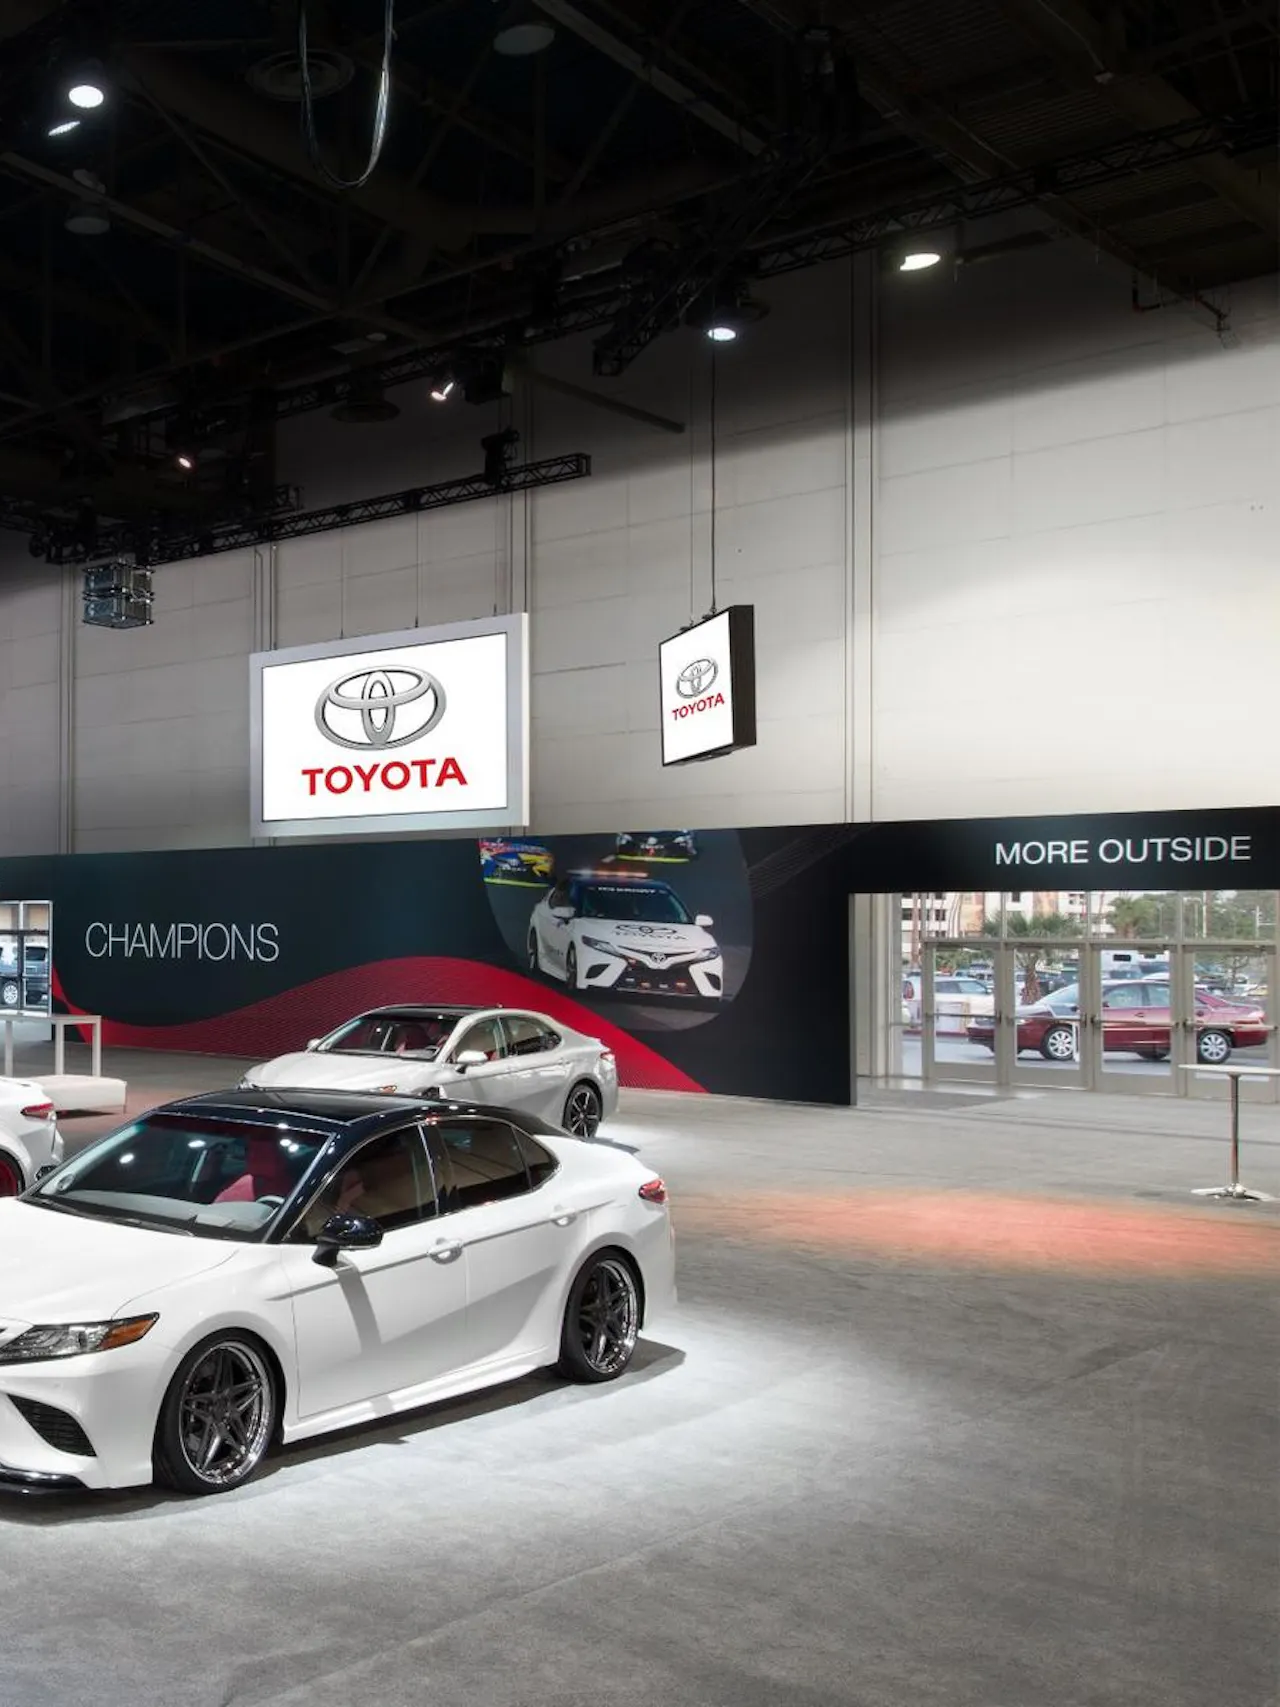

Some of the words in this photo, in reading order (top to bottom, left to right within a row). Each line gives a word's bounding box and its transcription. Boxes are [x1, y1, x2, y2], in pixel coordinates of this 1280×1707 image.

[672, 693, 725, 721] TOYOTA
[302, 757, 468, 796] TOYOTA
[995, 840, 1089, 865] MORE
[1099, 835, 1252, 863] OUTSIDE
[85, 922, 280, 962] CHAMPIONS
